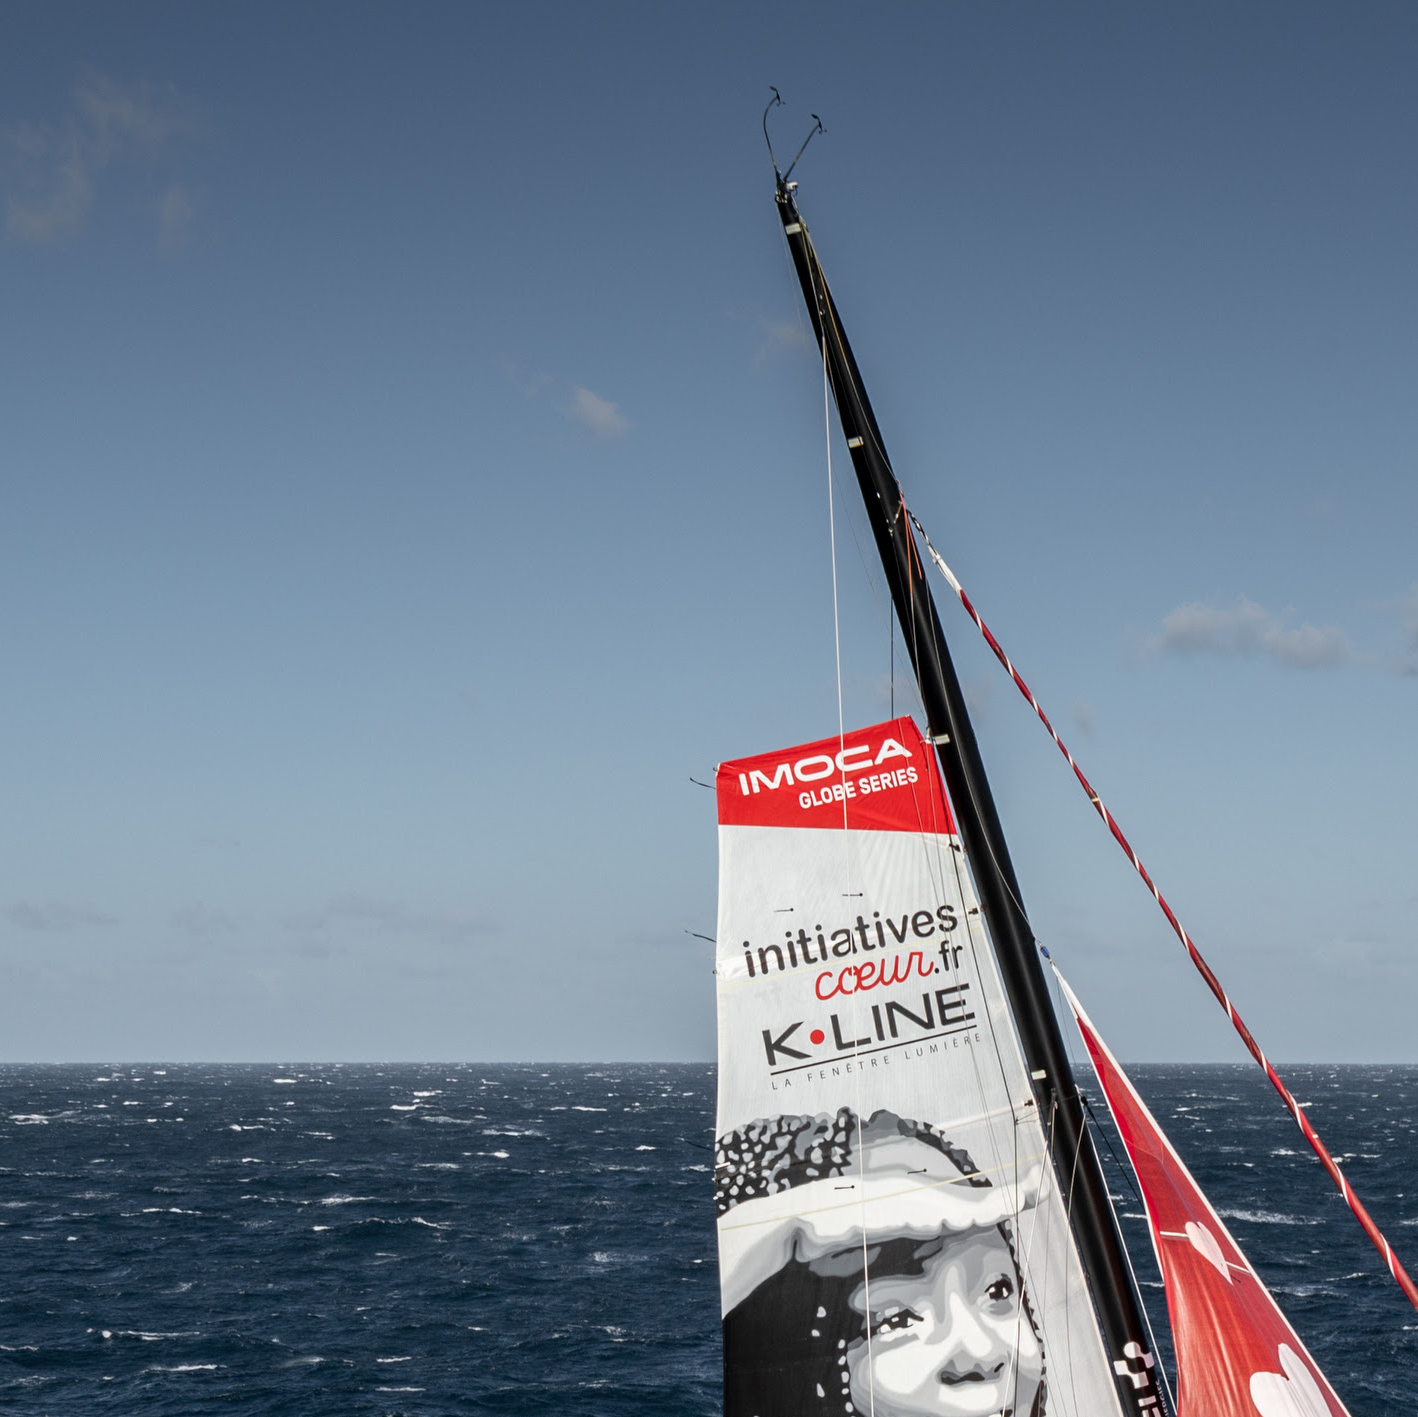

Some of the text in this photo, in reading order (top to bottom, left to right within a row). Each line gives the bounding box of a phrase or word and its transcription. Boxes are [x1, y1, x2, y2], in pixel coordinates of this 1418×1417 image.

[738, 737, 913, 797] IMOCA
[798, 766, 919, 810] GLOBE SERIES
[742, 903, 960, 979] initiatives
[771, 1032, 982, 1092] LA FENÊTRE LUMIÈRE
